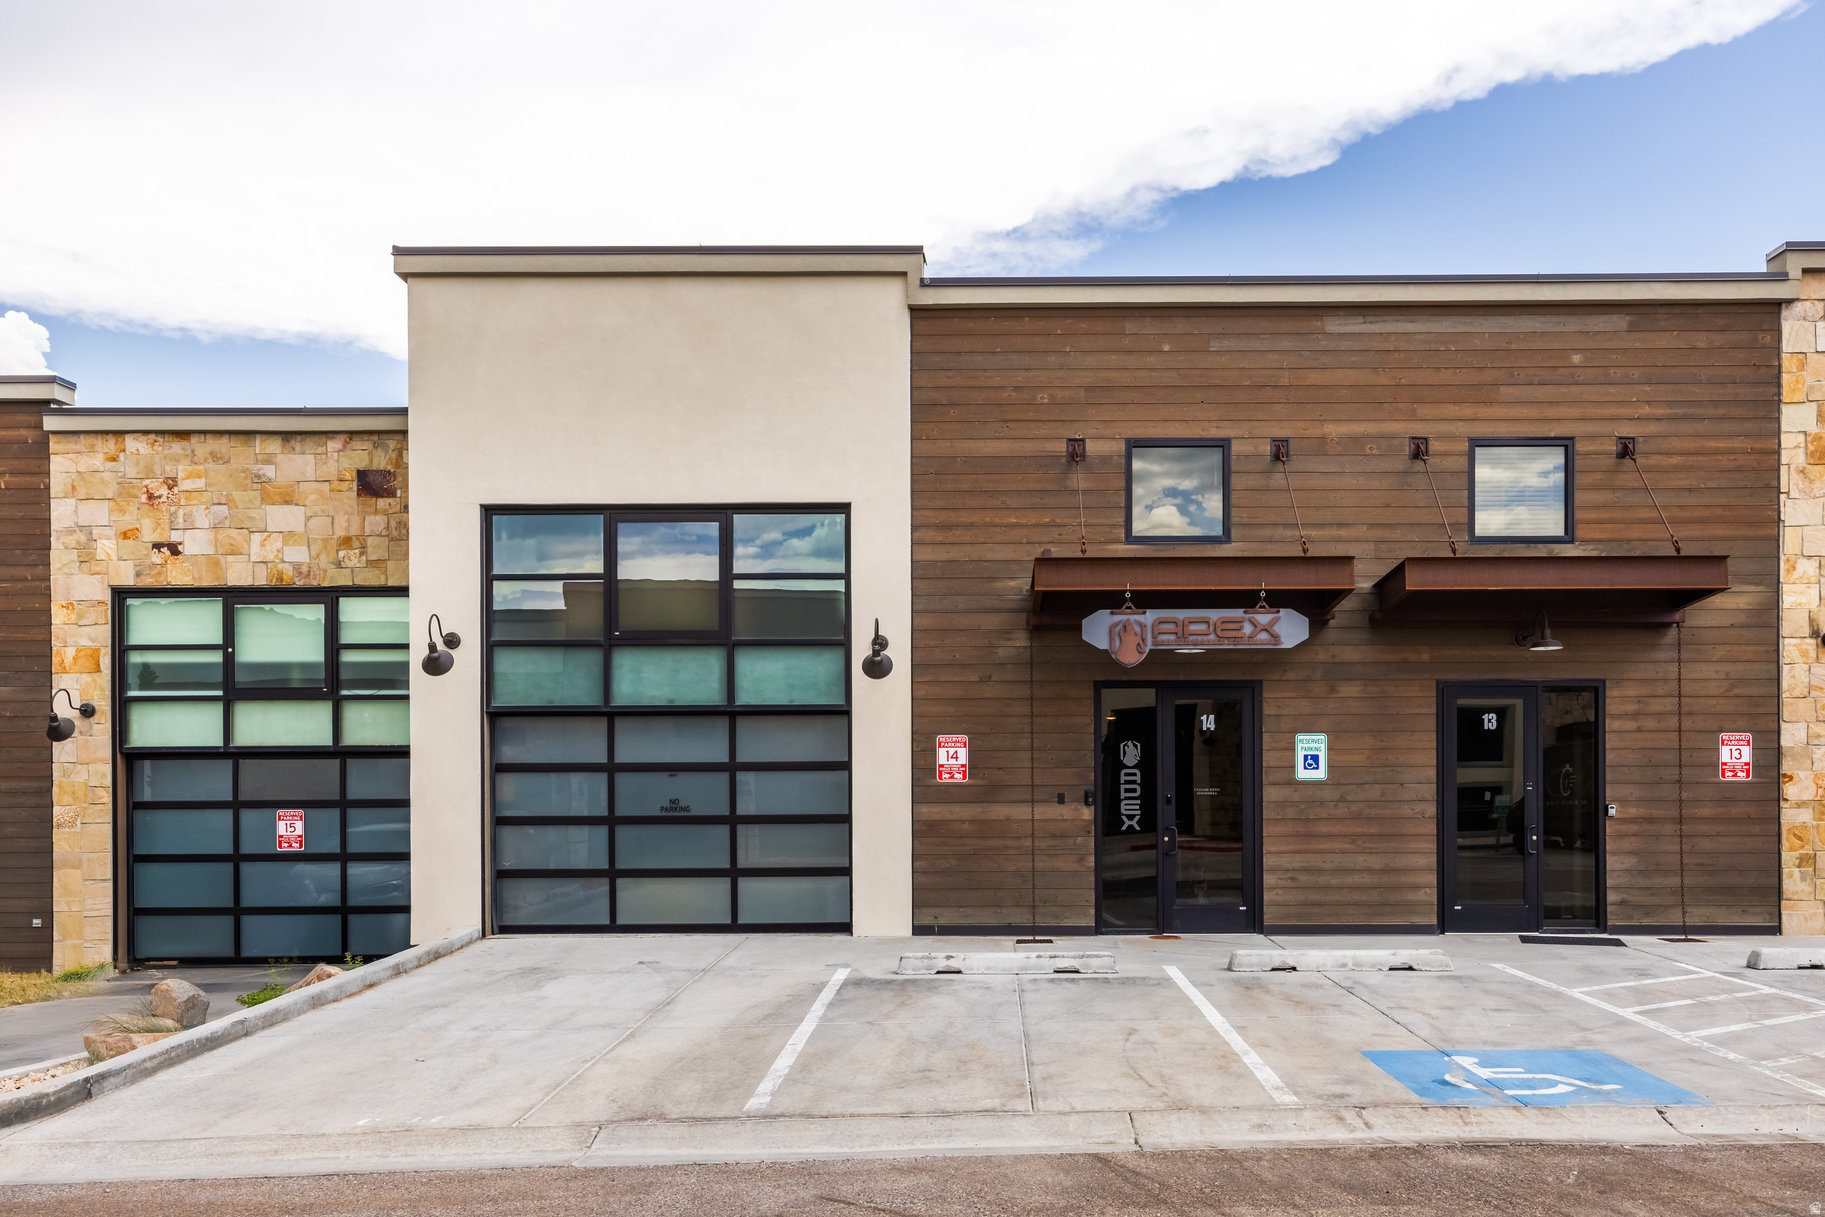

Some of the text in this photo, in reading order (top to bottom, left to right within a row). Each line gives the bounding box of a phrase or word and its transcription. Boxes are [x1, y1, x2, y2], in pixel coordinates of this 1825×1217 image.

[1152, 616, 1281, 639] APEX
[1200, 714, 1216, 731] 14
[1481, 713, 1498, 731] 13
[945, 750, 959, 762] 14
[1729, 748, 1742, 760] 13
[1120, 769, 1141, 830] APEX
[660, 805, 691, 813] PARKING
[285, 822, 297, 833] 15
